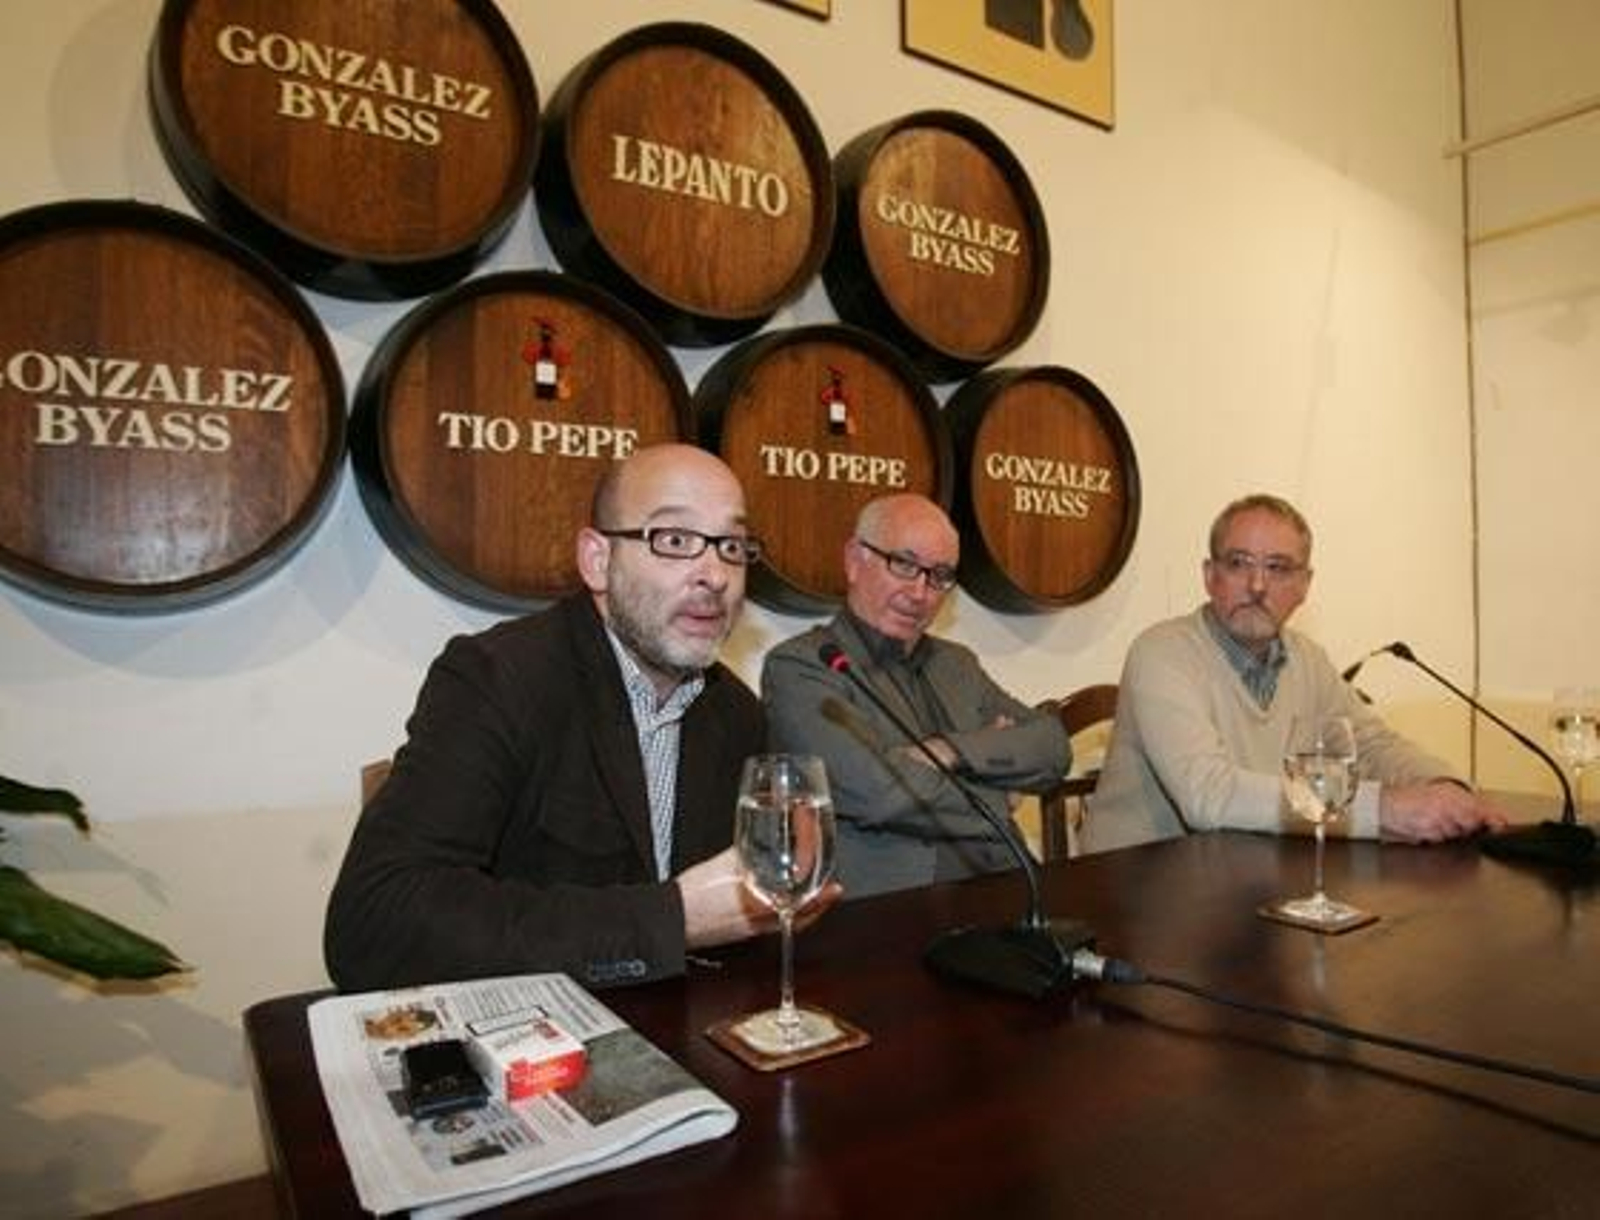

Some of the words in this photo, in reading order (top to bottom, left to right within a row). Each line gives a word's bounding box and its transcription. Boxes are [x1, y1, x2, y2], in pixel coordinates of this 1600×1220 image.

[217, 25, 492, 118] GONZALEZ
[279, 80, 441, 146] BYASS
[612, 135, 788, 217] LEPANTO
[876, 194, 1020, 255] GONZALEZ
[908, 231, 995, 276] BYASS
[0, 351, 292, 412] ONZALEZ
[36, 404, 232, 452] BYASS
[438, 412, 520, 452] TIO
[760, 445, 819, 479] TIO
[827, 452, 906, 488] PEPE
[986, 453, 1112, 494] GONZALEZ
[1014, 487, 1089, 518] BYASS
